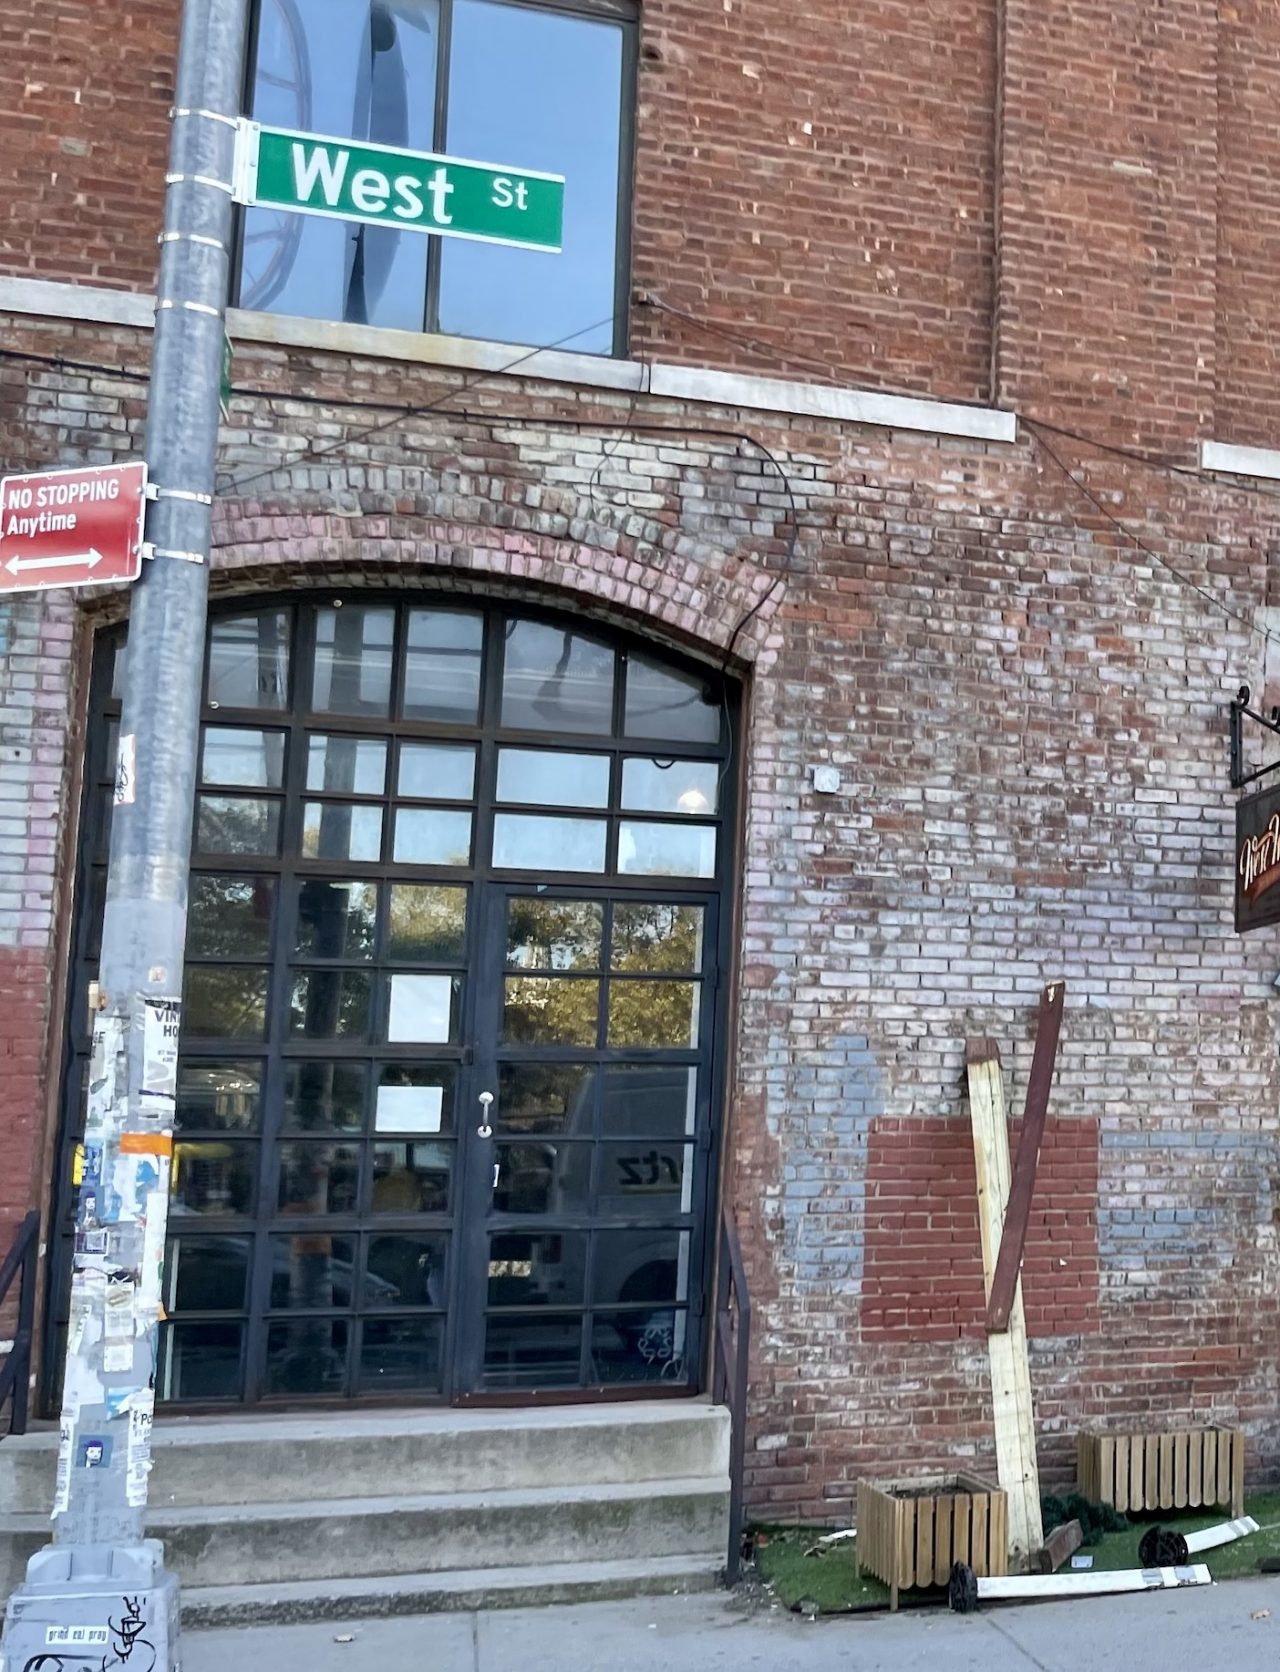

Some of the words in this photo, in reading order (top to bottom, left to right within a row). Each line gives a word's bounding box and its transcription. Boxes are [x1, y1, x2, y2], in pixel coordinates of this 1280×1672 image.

[292, 142, 454, 225] West
[491, 177, 529, 212] St
[8, 488, 33, 510] NO
[36, 478, 119, 507] STOPPING
[7, 510, 77, 538] Anytime
[154, 1009, 180, 1023] VIN
